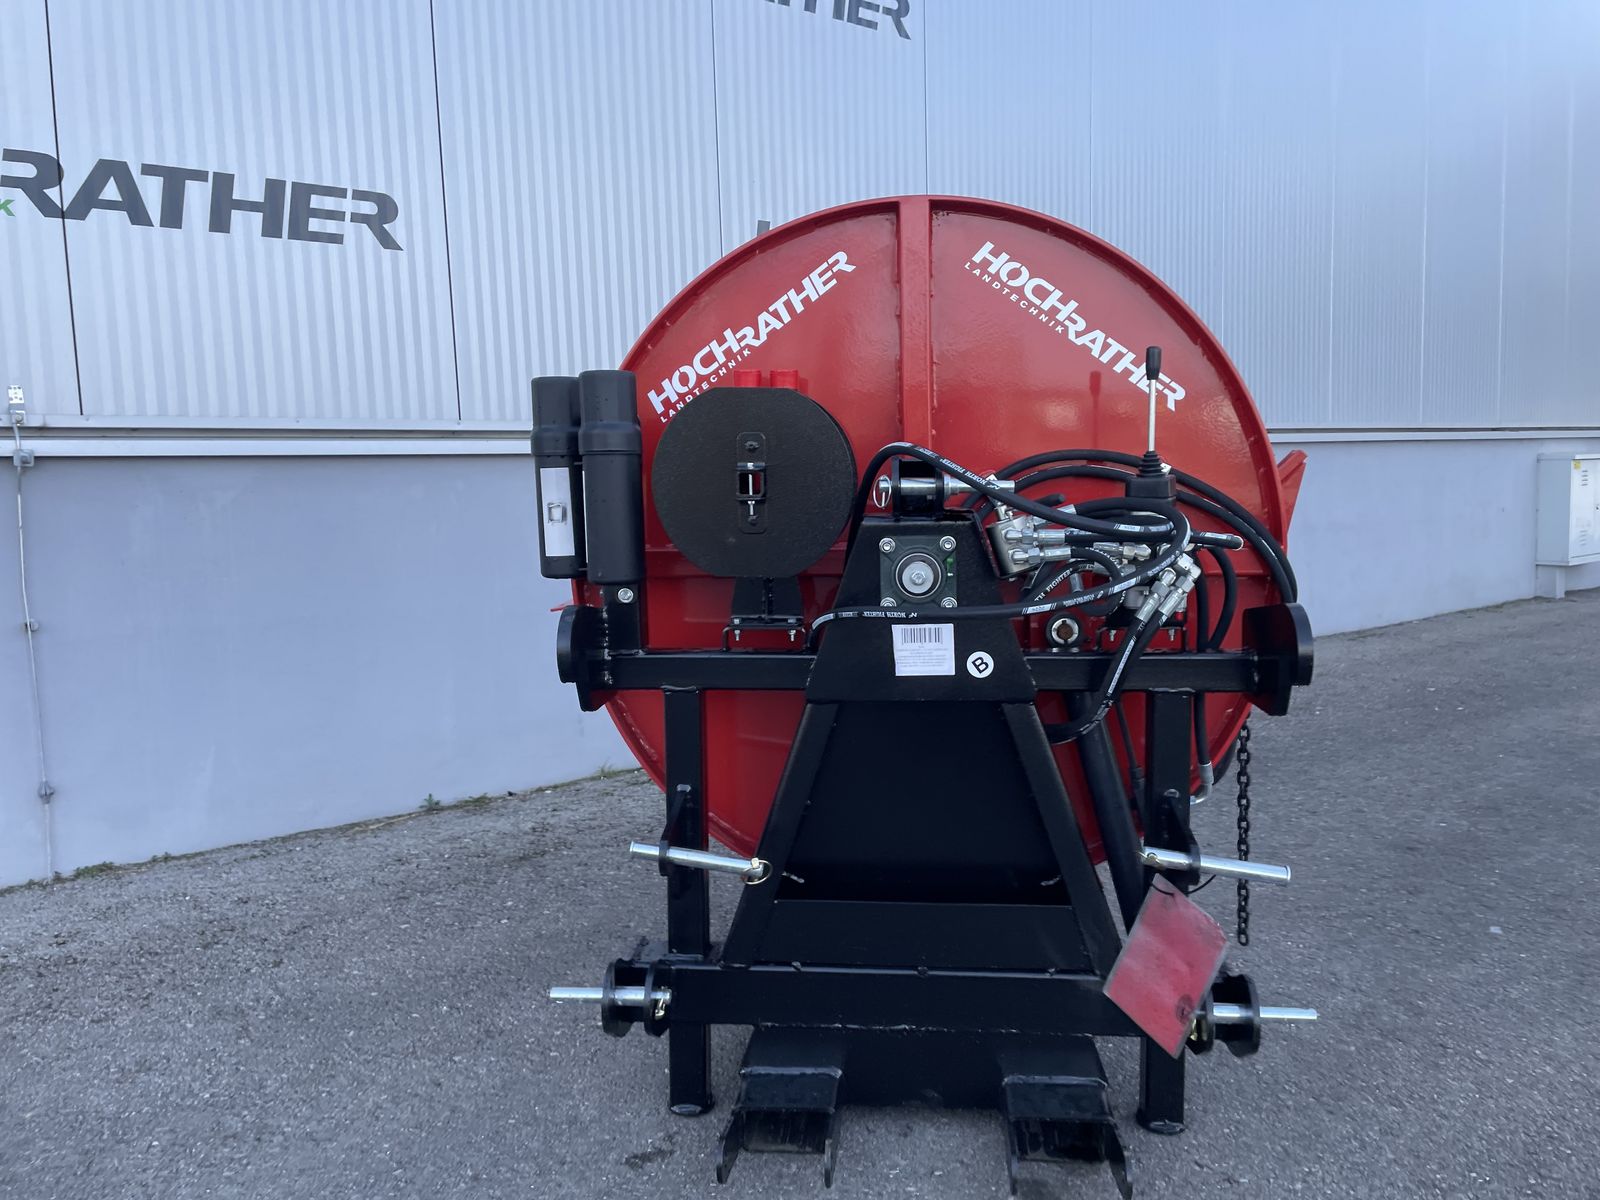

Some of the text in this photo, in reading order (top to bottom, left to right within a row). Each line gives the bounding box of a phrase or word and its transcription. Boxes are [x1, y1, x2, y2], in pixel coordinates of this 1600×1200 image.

[647, 251, 857, 415] HOCHRATHER
[964, 261, 1065, 334] LANDTECHNIK
[660, 348, 751, 423] LANDTECHNIK
[971, 656, 989, 674] B
